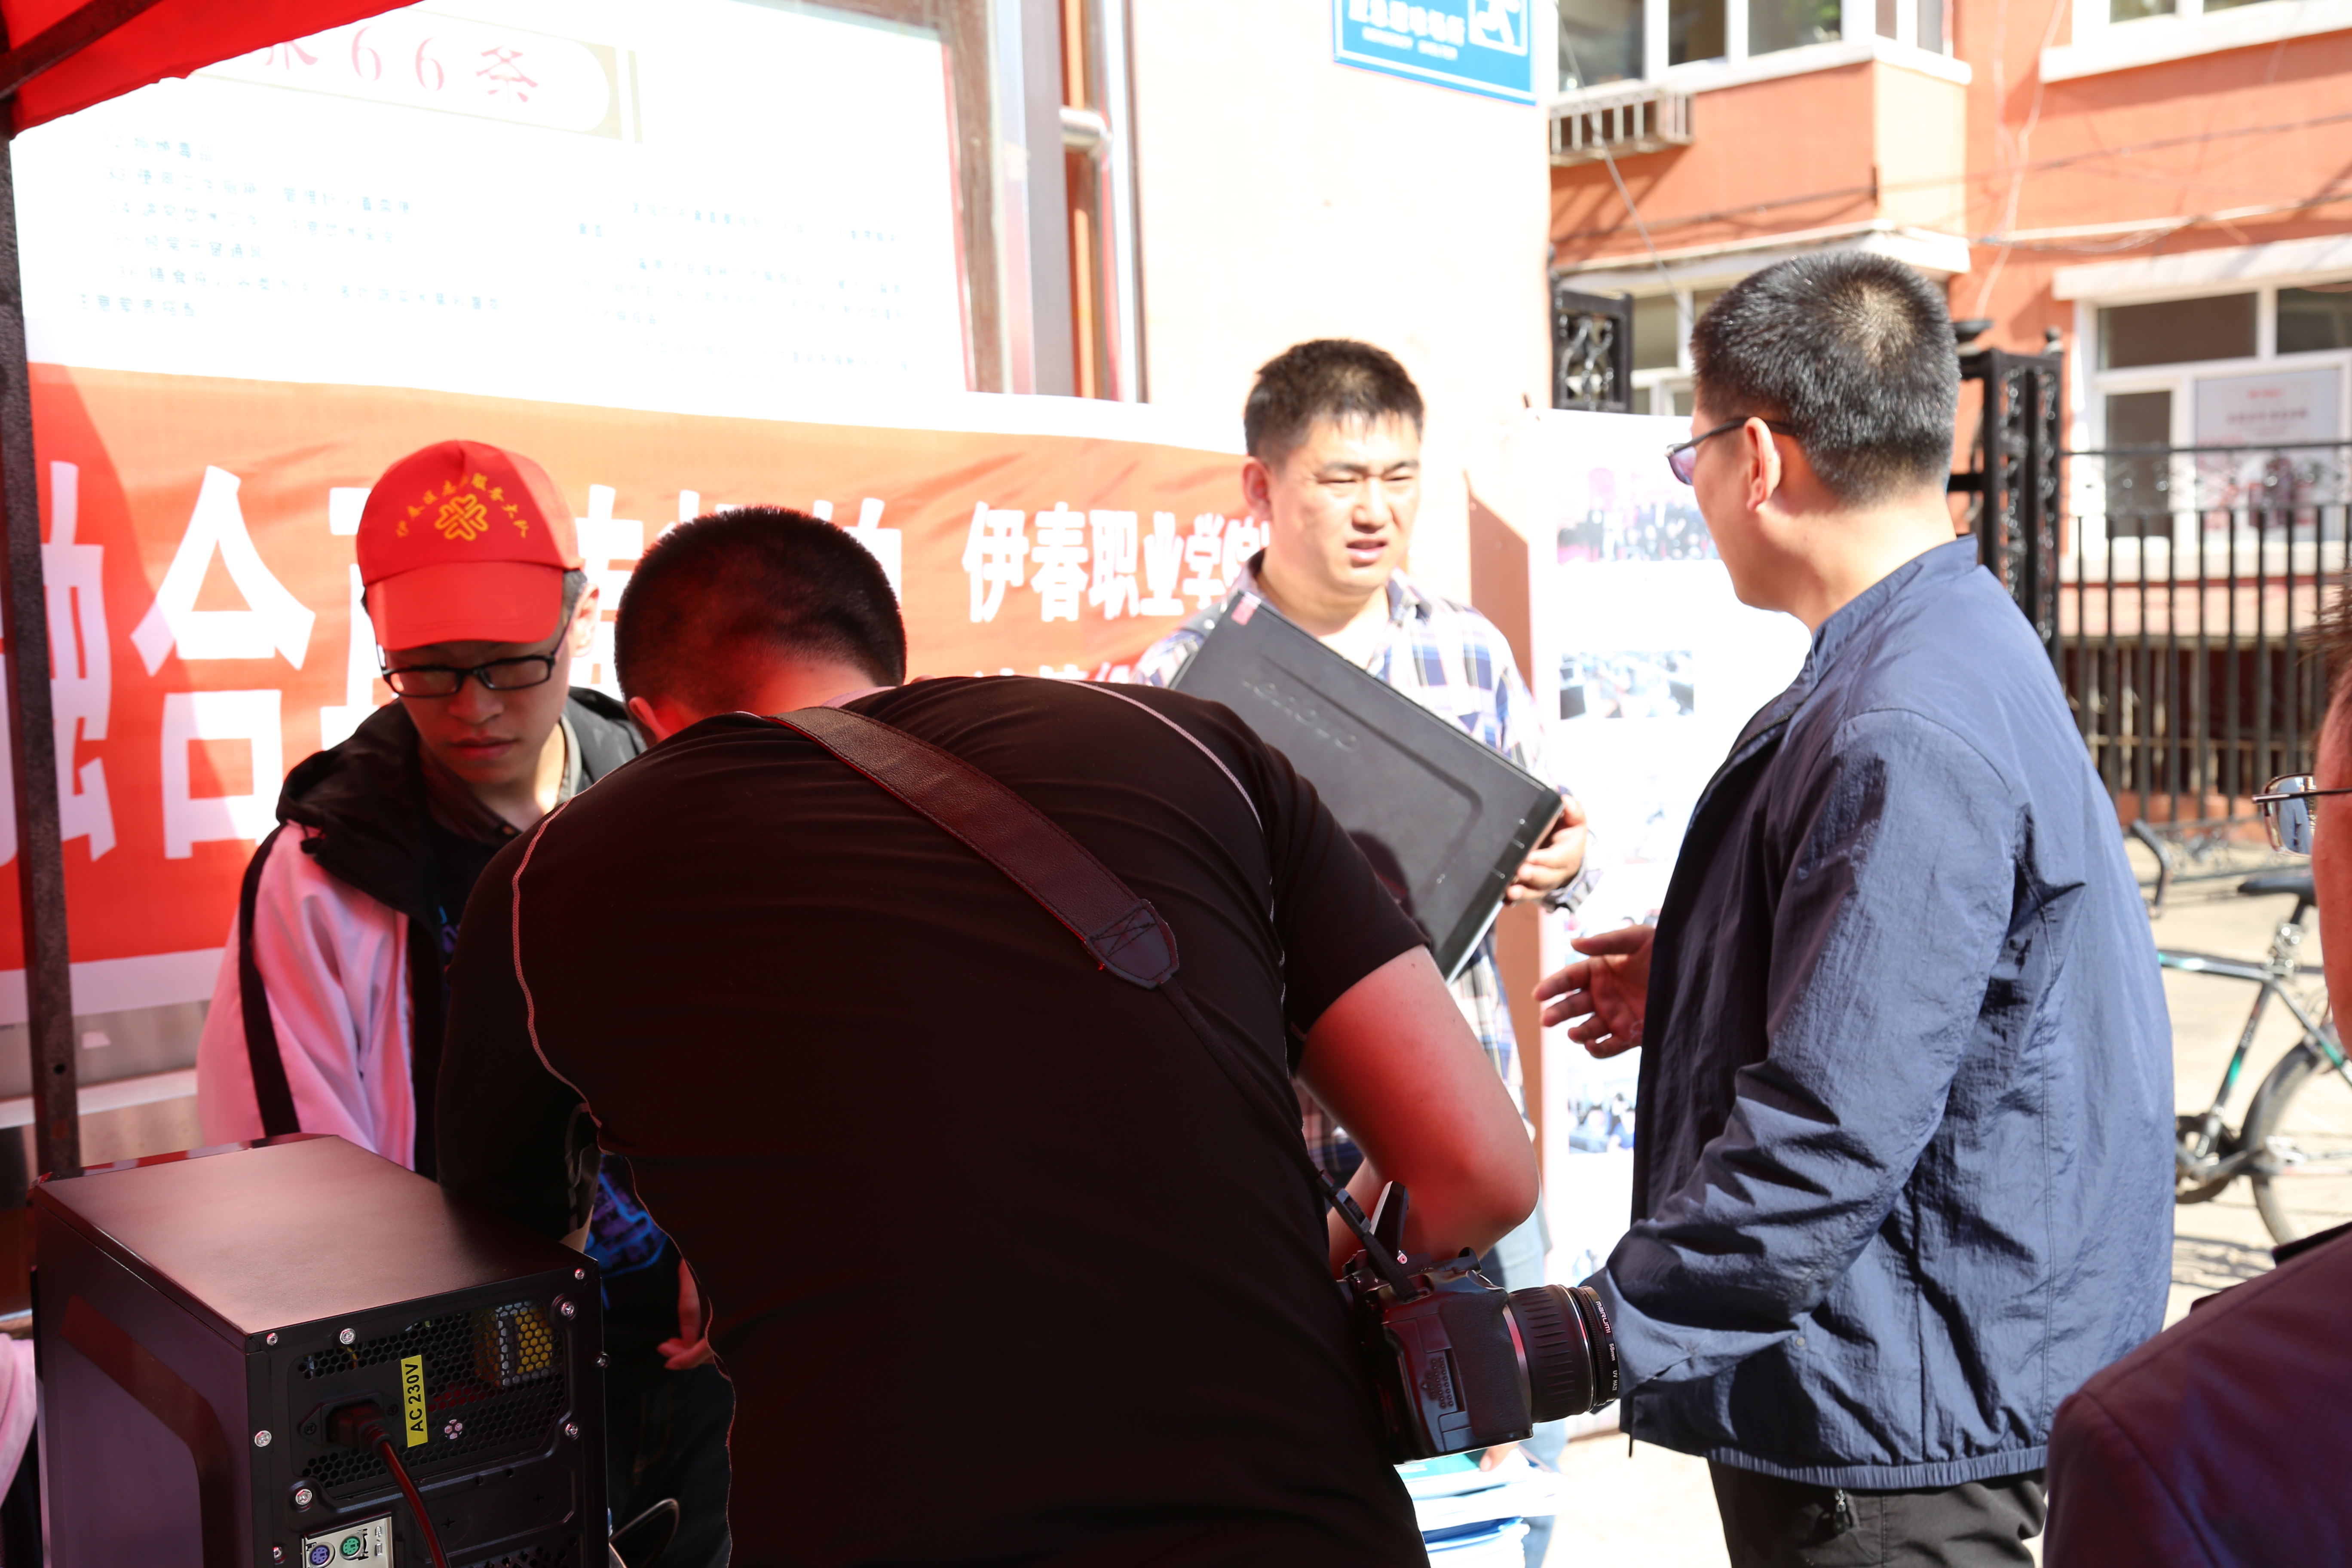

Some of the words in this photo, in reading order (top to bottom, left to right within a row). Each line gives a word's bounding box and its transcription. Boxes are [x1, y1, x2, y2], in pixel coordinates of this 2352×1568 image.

[405, 1364, 422, 1404] 230V
[1613, 1370, 1618, 1378] UV
[410, 1408, 424, 1432] AC
